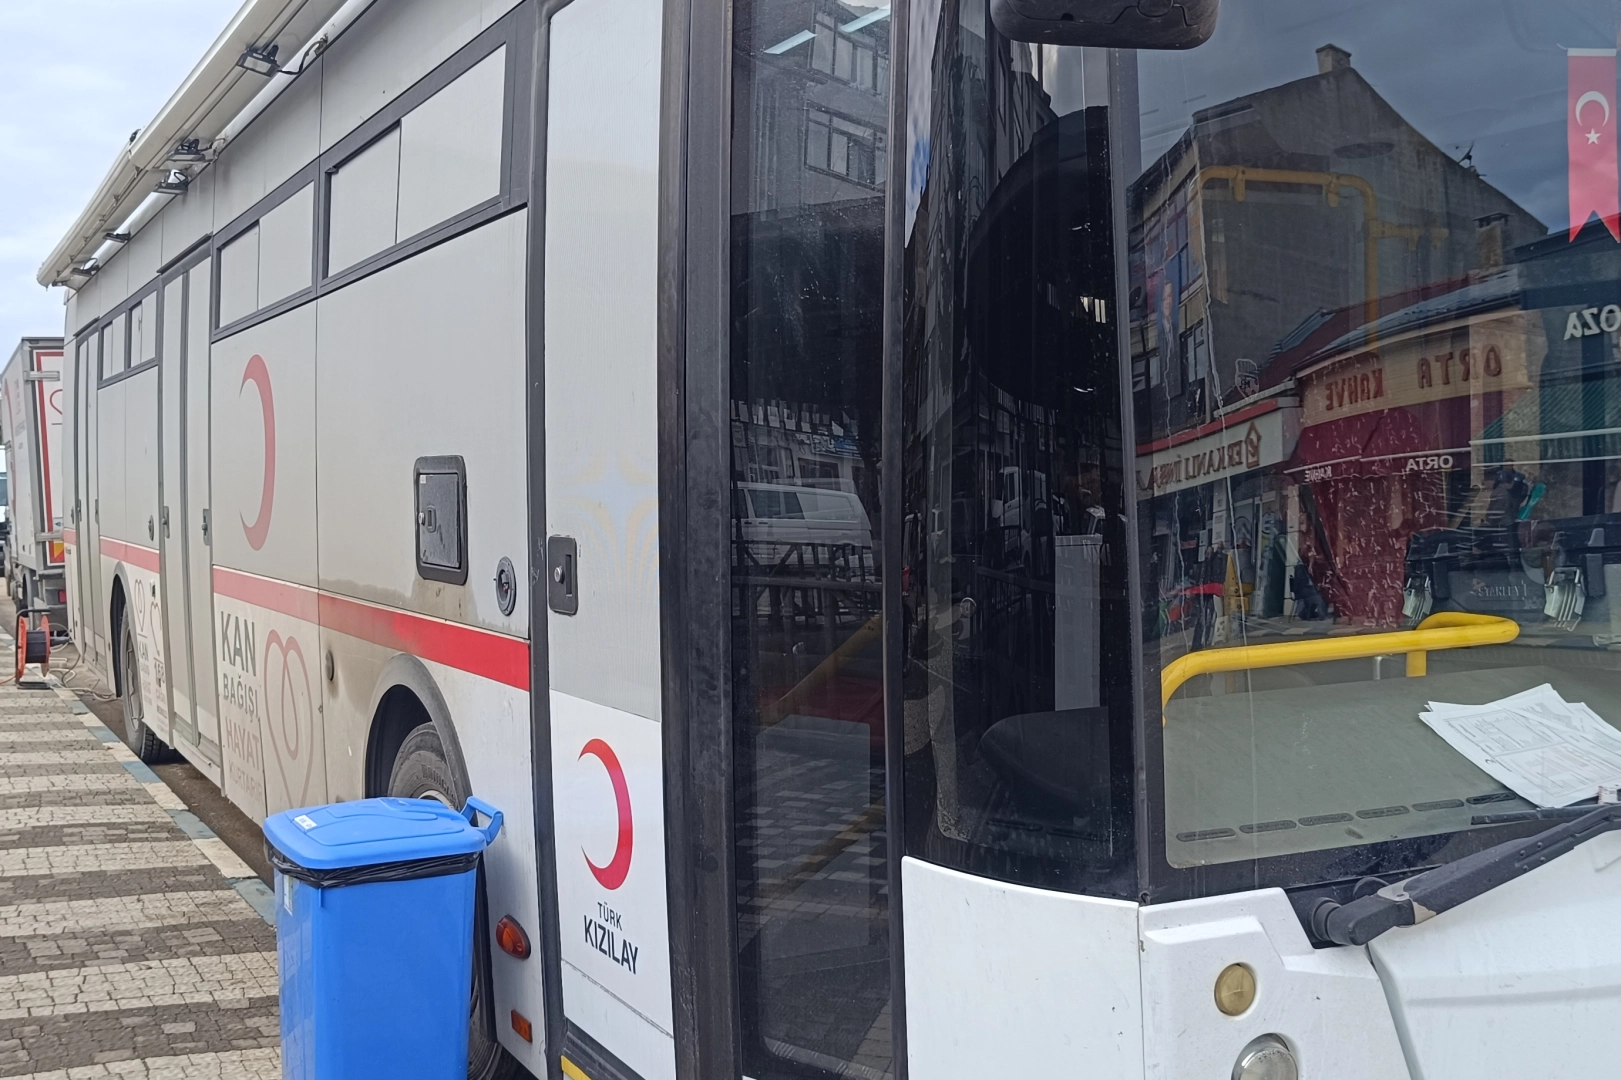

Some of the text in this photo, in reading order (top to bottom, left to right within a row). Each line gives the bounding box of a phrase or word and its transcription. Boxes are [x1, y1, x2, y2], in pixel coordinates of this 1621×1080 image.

[221, 611, 257, 677] KAN
[222, 673, 259, 723] BAĞIŞI
[225, 716, 260, 771] HAYAT
[597, 901, 622, 931] TÜRK
[583, 914, 639, 975] KIZILAY
